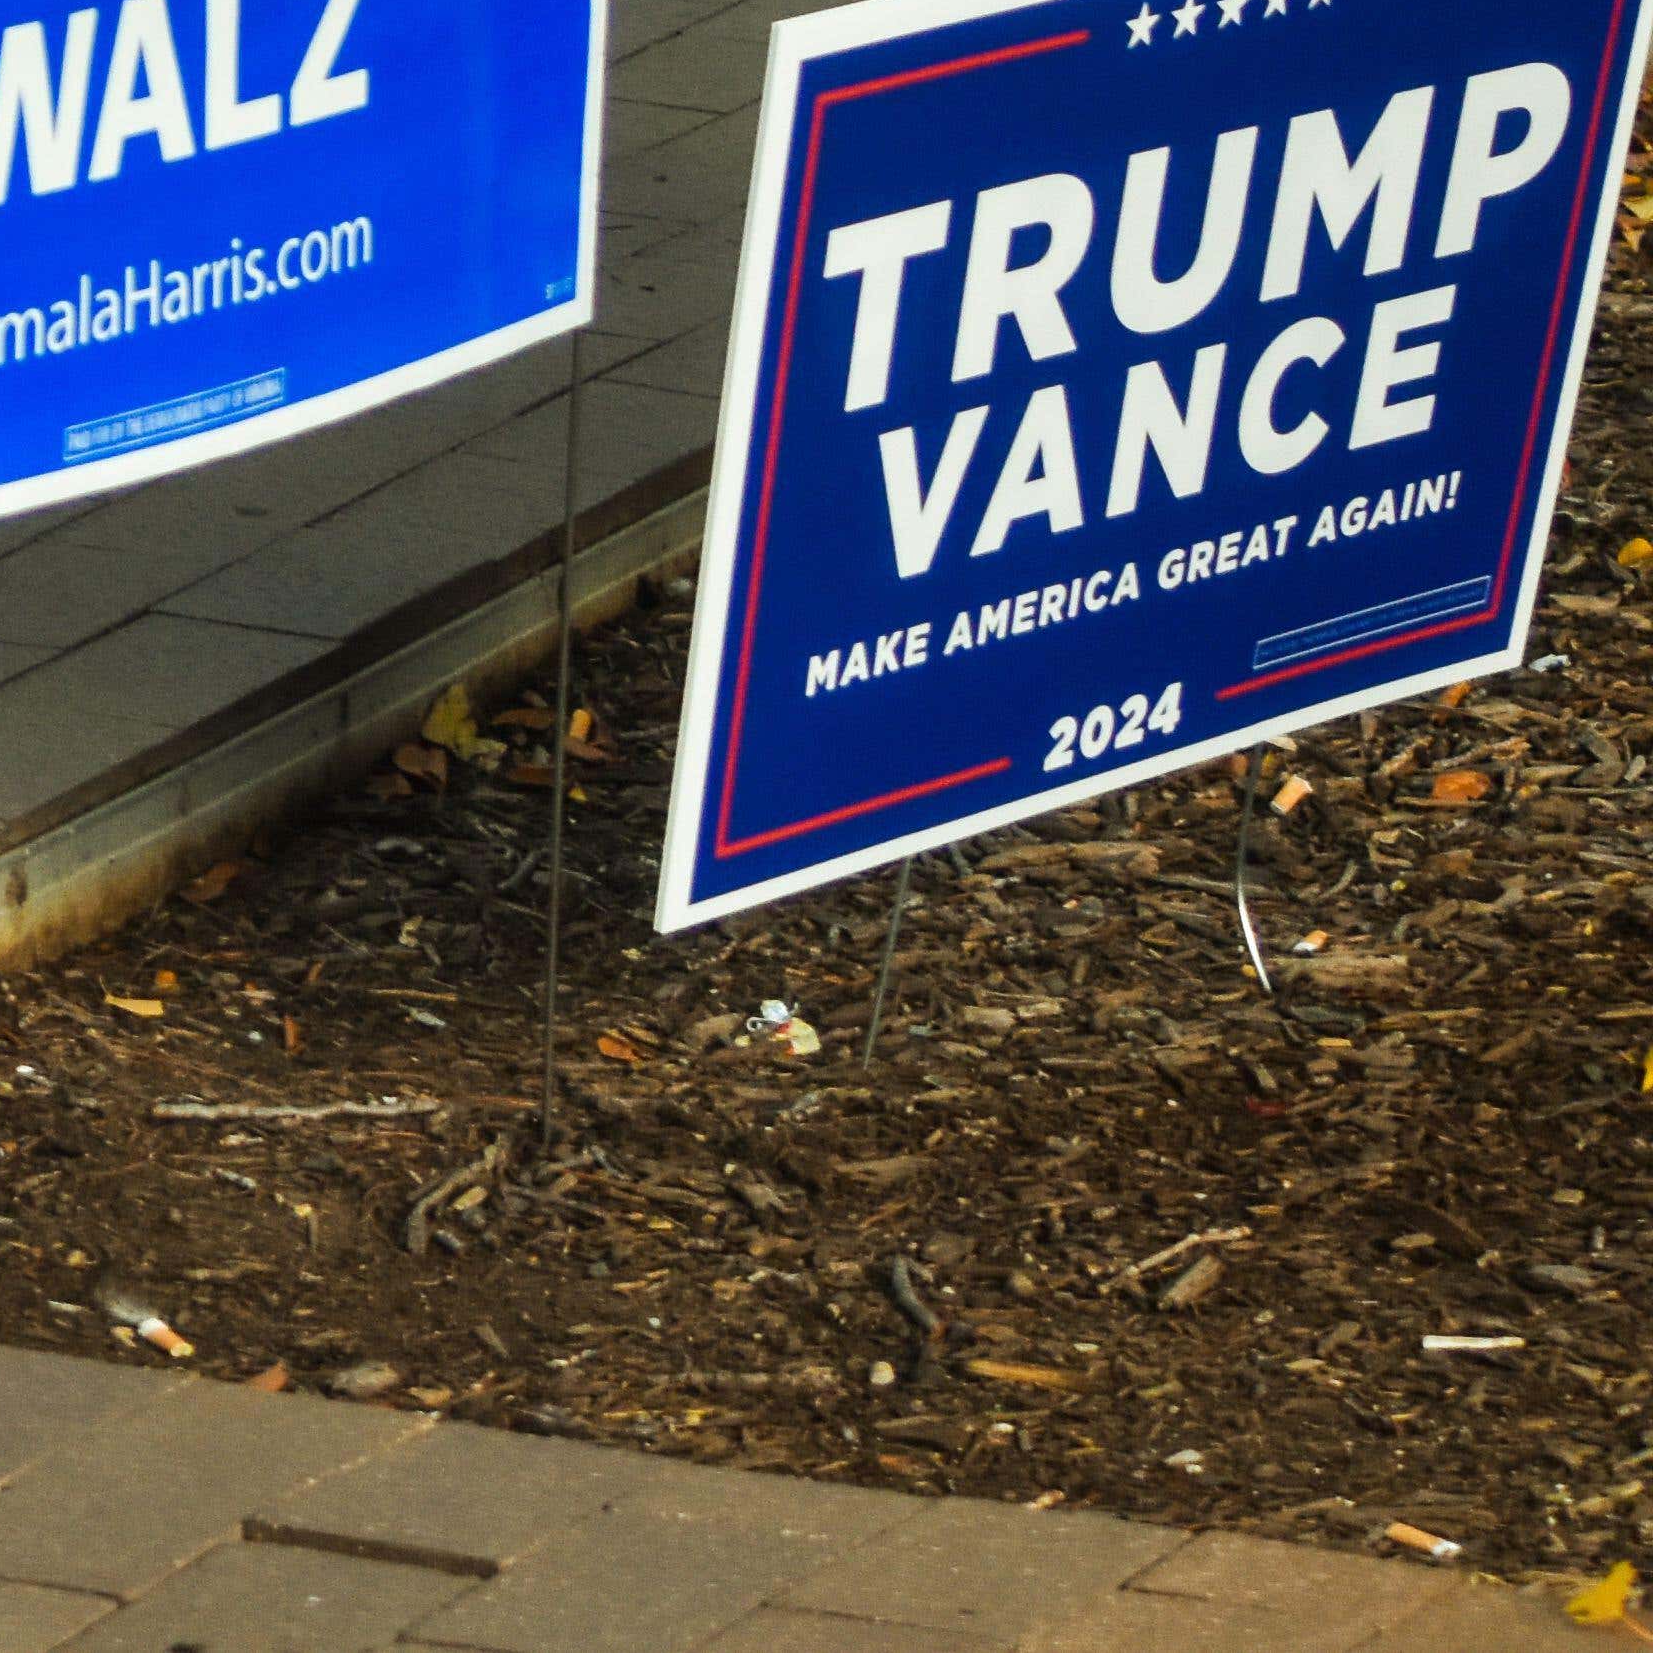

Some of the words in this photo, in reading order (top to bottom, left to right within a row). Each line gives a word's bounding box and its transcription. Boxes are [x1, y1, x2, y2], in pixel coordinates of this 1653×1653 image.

[822, 61, 1573, 414] TRUMP
[877, 283, 1458, 581] VANCE
[804, 621, 932, 699] MAKE
[942, 561, 1141, 656] AMERICA
[1156, 514, 1299, 592] GREAT
[1307, 469, 1463, 547] AGAIN!
[1042, 680, 1184, 773] 2024
